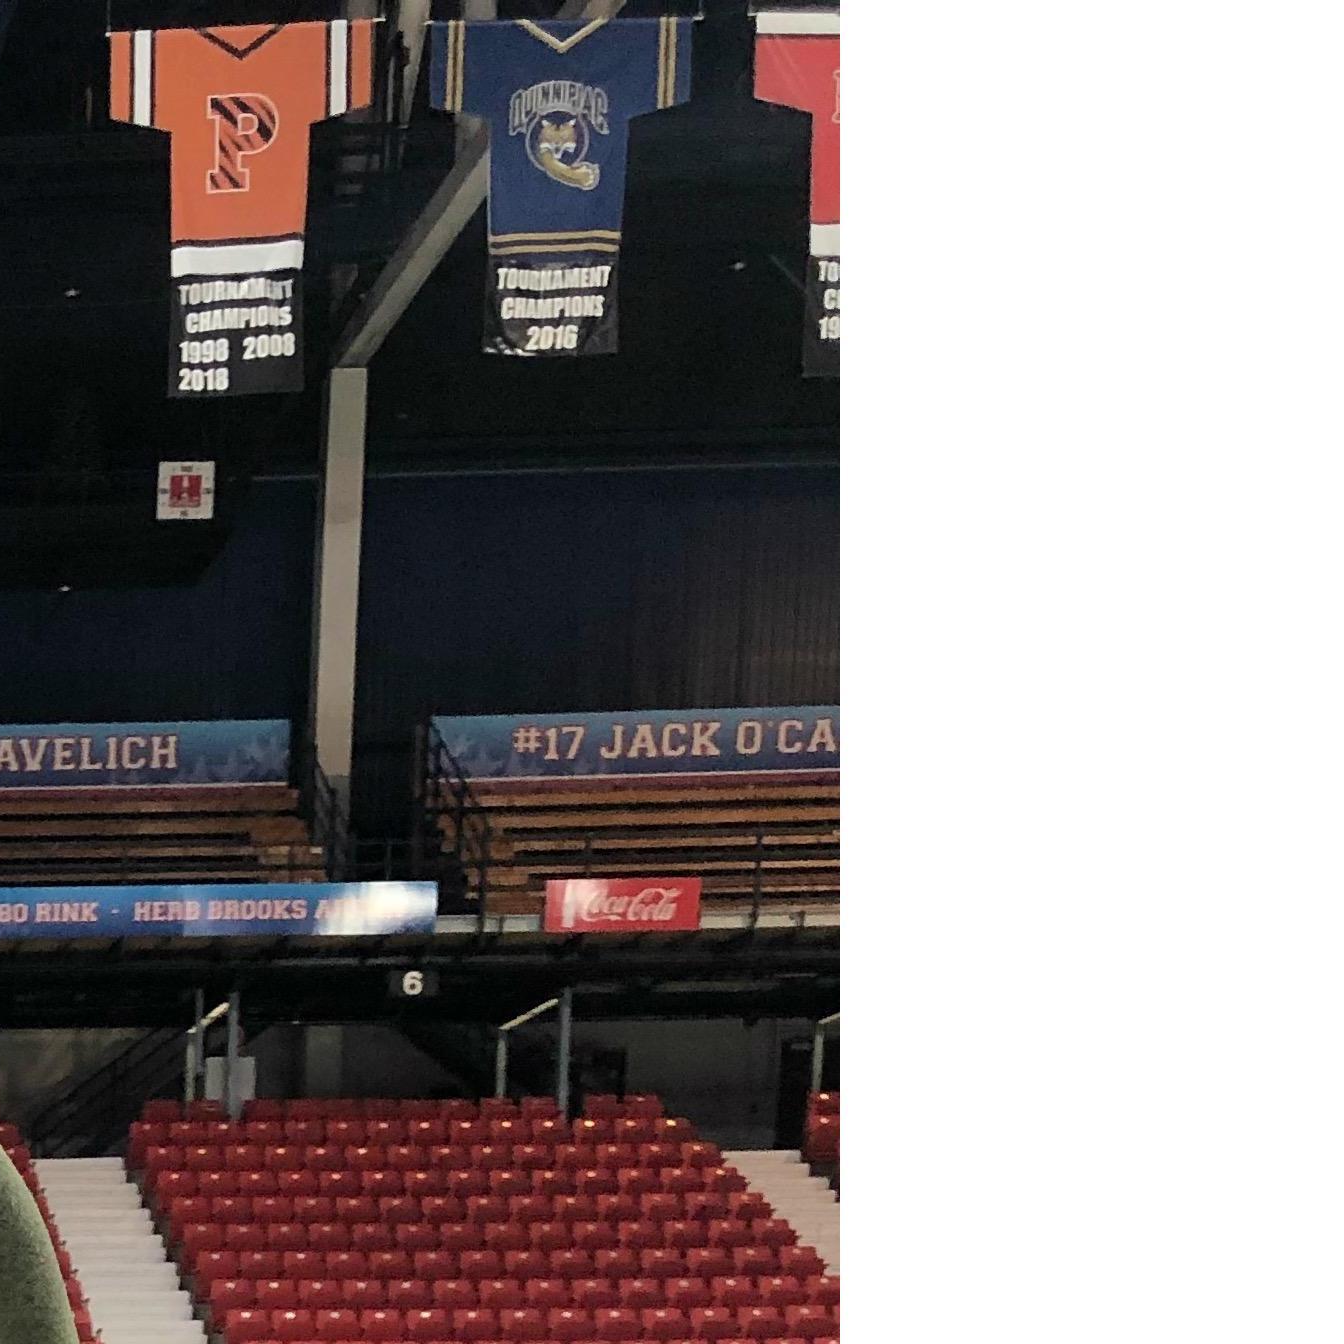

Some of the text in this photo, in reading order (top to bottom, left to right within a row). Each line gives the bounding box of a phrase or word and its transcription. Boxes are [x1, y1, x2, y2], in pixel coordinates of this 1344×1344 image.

[206, 93, 279, 194] P
[177, 277, 293, 305] TOURNAMENT
[497, 265, 611, 291] TOURNAMENT
[185, 305, 293, 333] CHAMPIONS
[500, 294, 605, 319] CHAMPIONS
[179, 332, 296, 364] 1998 2008
[525, 324, 579, 350] 2016
[178, 367, 230, 391] 2018
[512, 724, 586, 760] #17
[599, 721, 722, 760] JACK
[34, 901, 100, 922] RINK
[132, 900, 202, 922] HERB
[207, 899, 309, 921] BROOKS
[402, 970, 424, 996] 6
